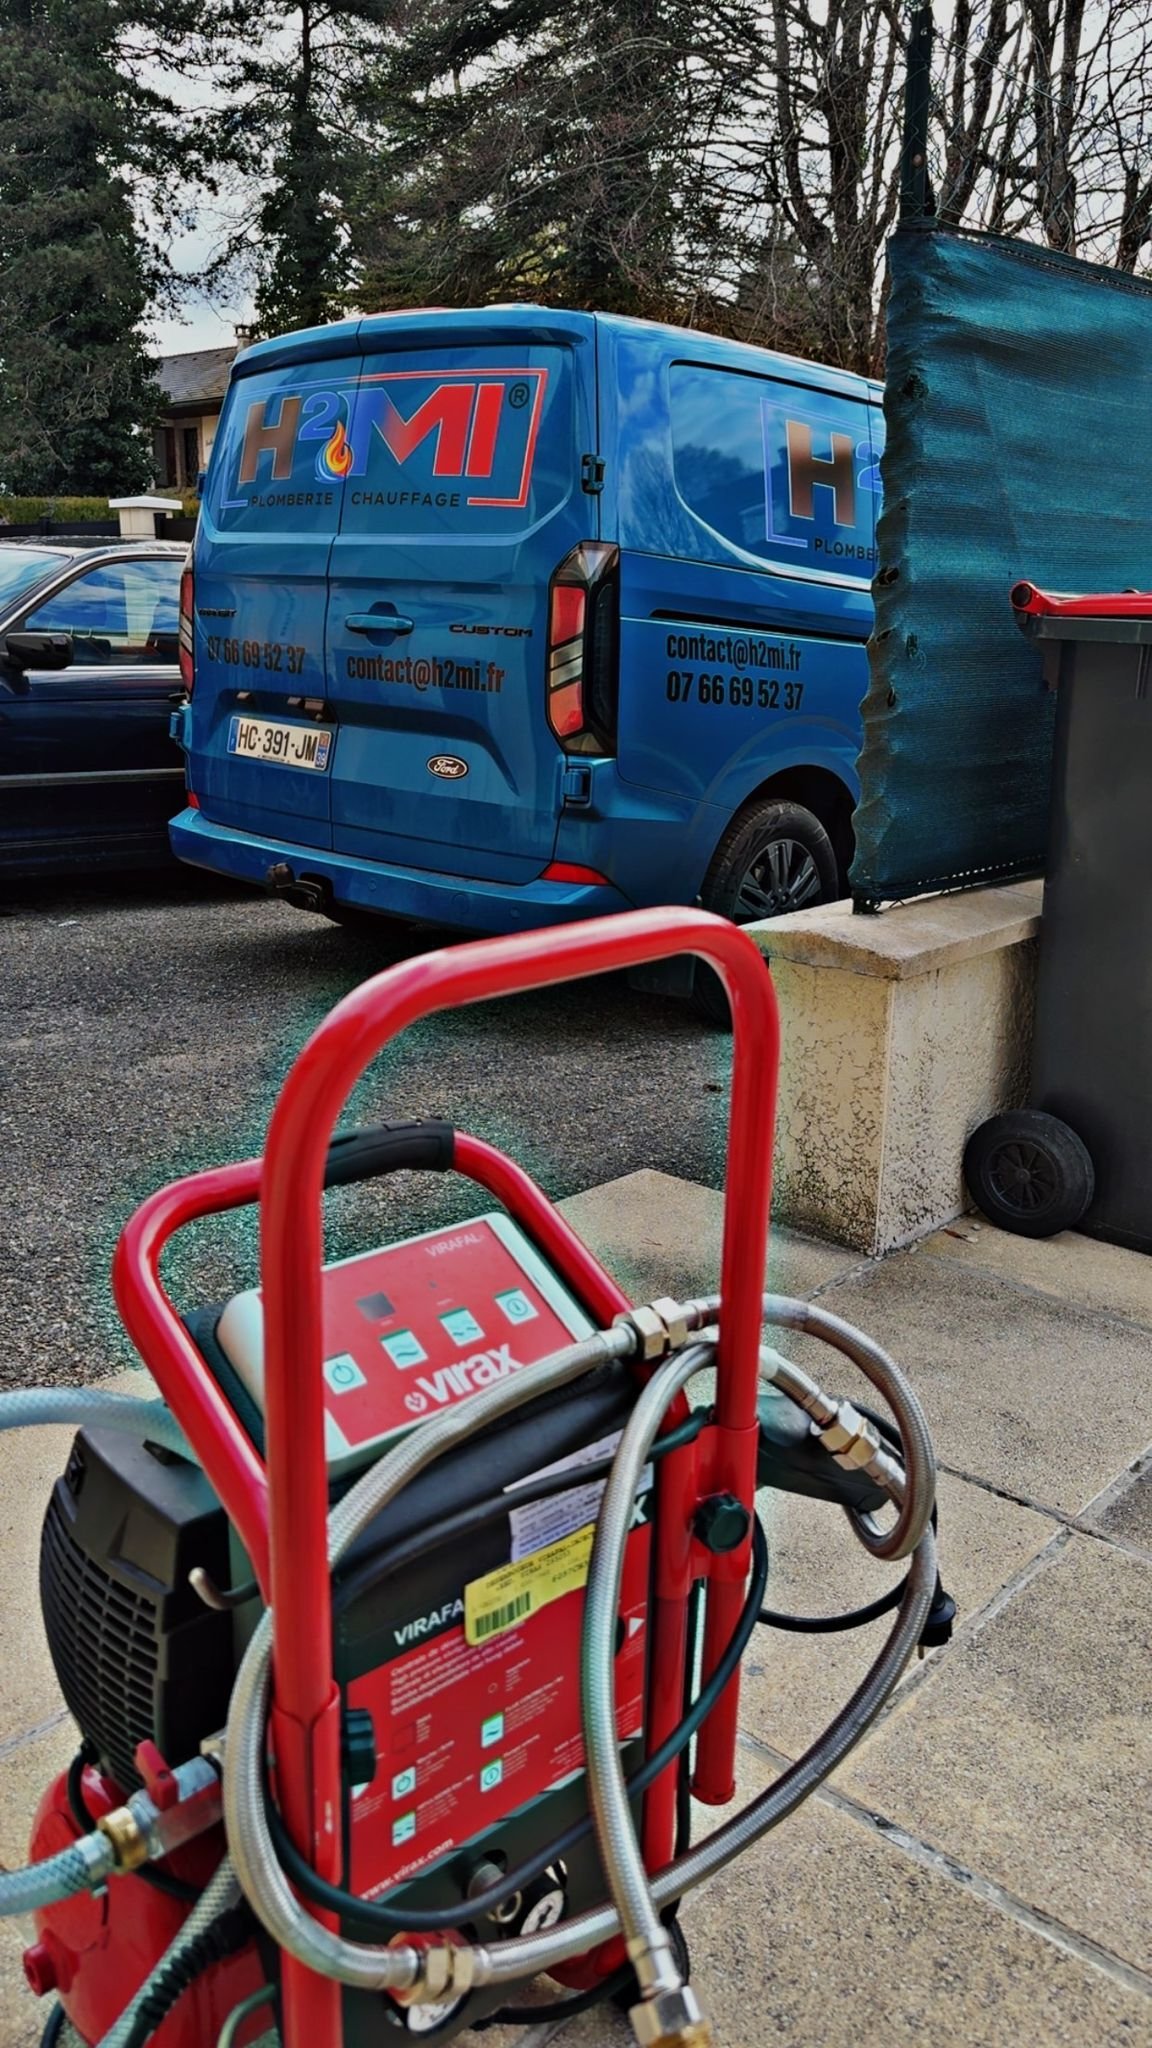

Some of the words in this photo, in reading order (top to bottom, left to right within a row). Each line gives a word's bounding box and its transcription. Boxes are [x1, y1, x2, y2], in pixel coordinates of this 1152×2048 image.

[786, 419, 885, 528] H2
[252, 491, 333, 507] PLOMBERIE
[351, 491, 461, 507] CHAUFFAGE
[449, 624, 533, 637] CUSTOM
[207, 636, 221, 662] 07
[223, 638, 240, 666] 66
[242, 640, 260, 669] 69
[263, 643, 283, 673] 52
[286, 646, 306, 675] 37
[666, 633, 802, 672] contact@h2mi.fr
[347, 653, 505, 693] contact@h2mi.fr
[666, 671, 694, 702] 07
[699, 672, 725, 705] 66
[729, 675, 754, 708] 69
[758, 678, 780, 710] 52
[784, 682, 804, 712] 37
[434, 759, 459, 774] Ford
[415, 1344, 525, 1404] virax
[394, 1599, 465, 1646] VIRAFA
